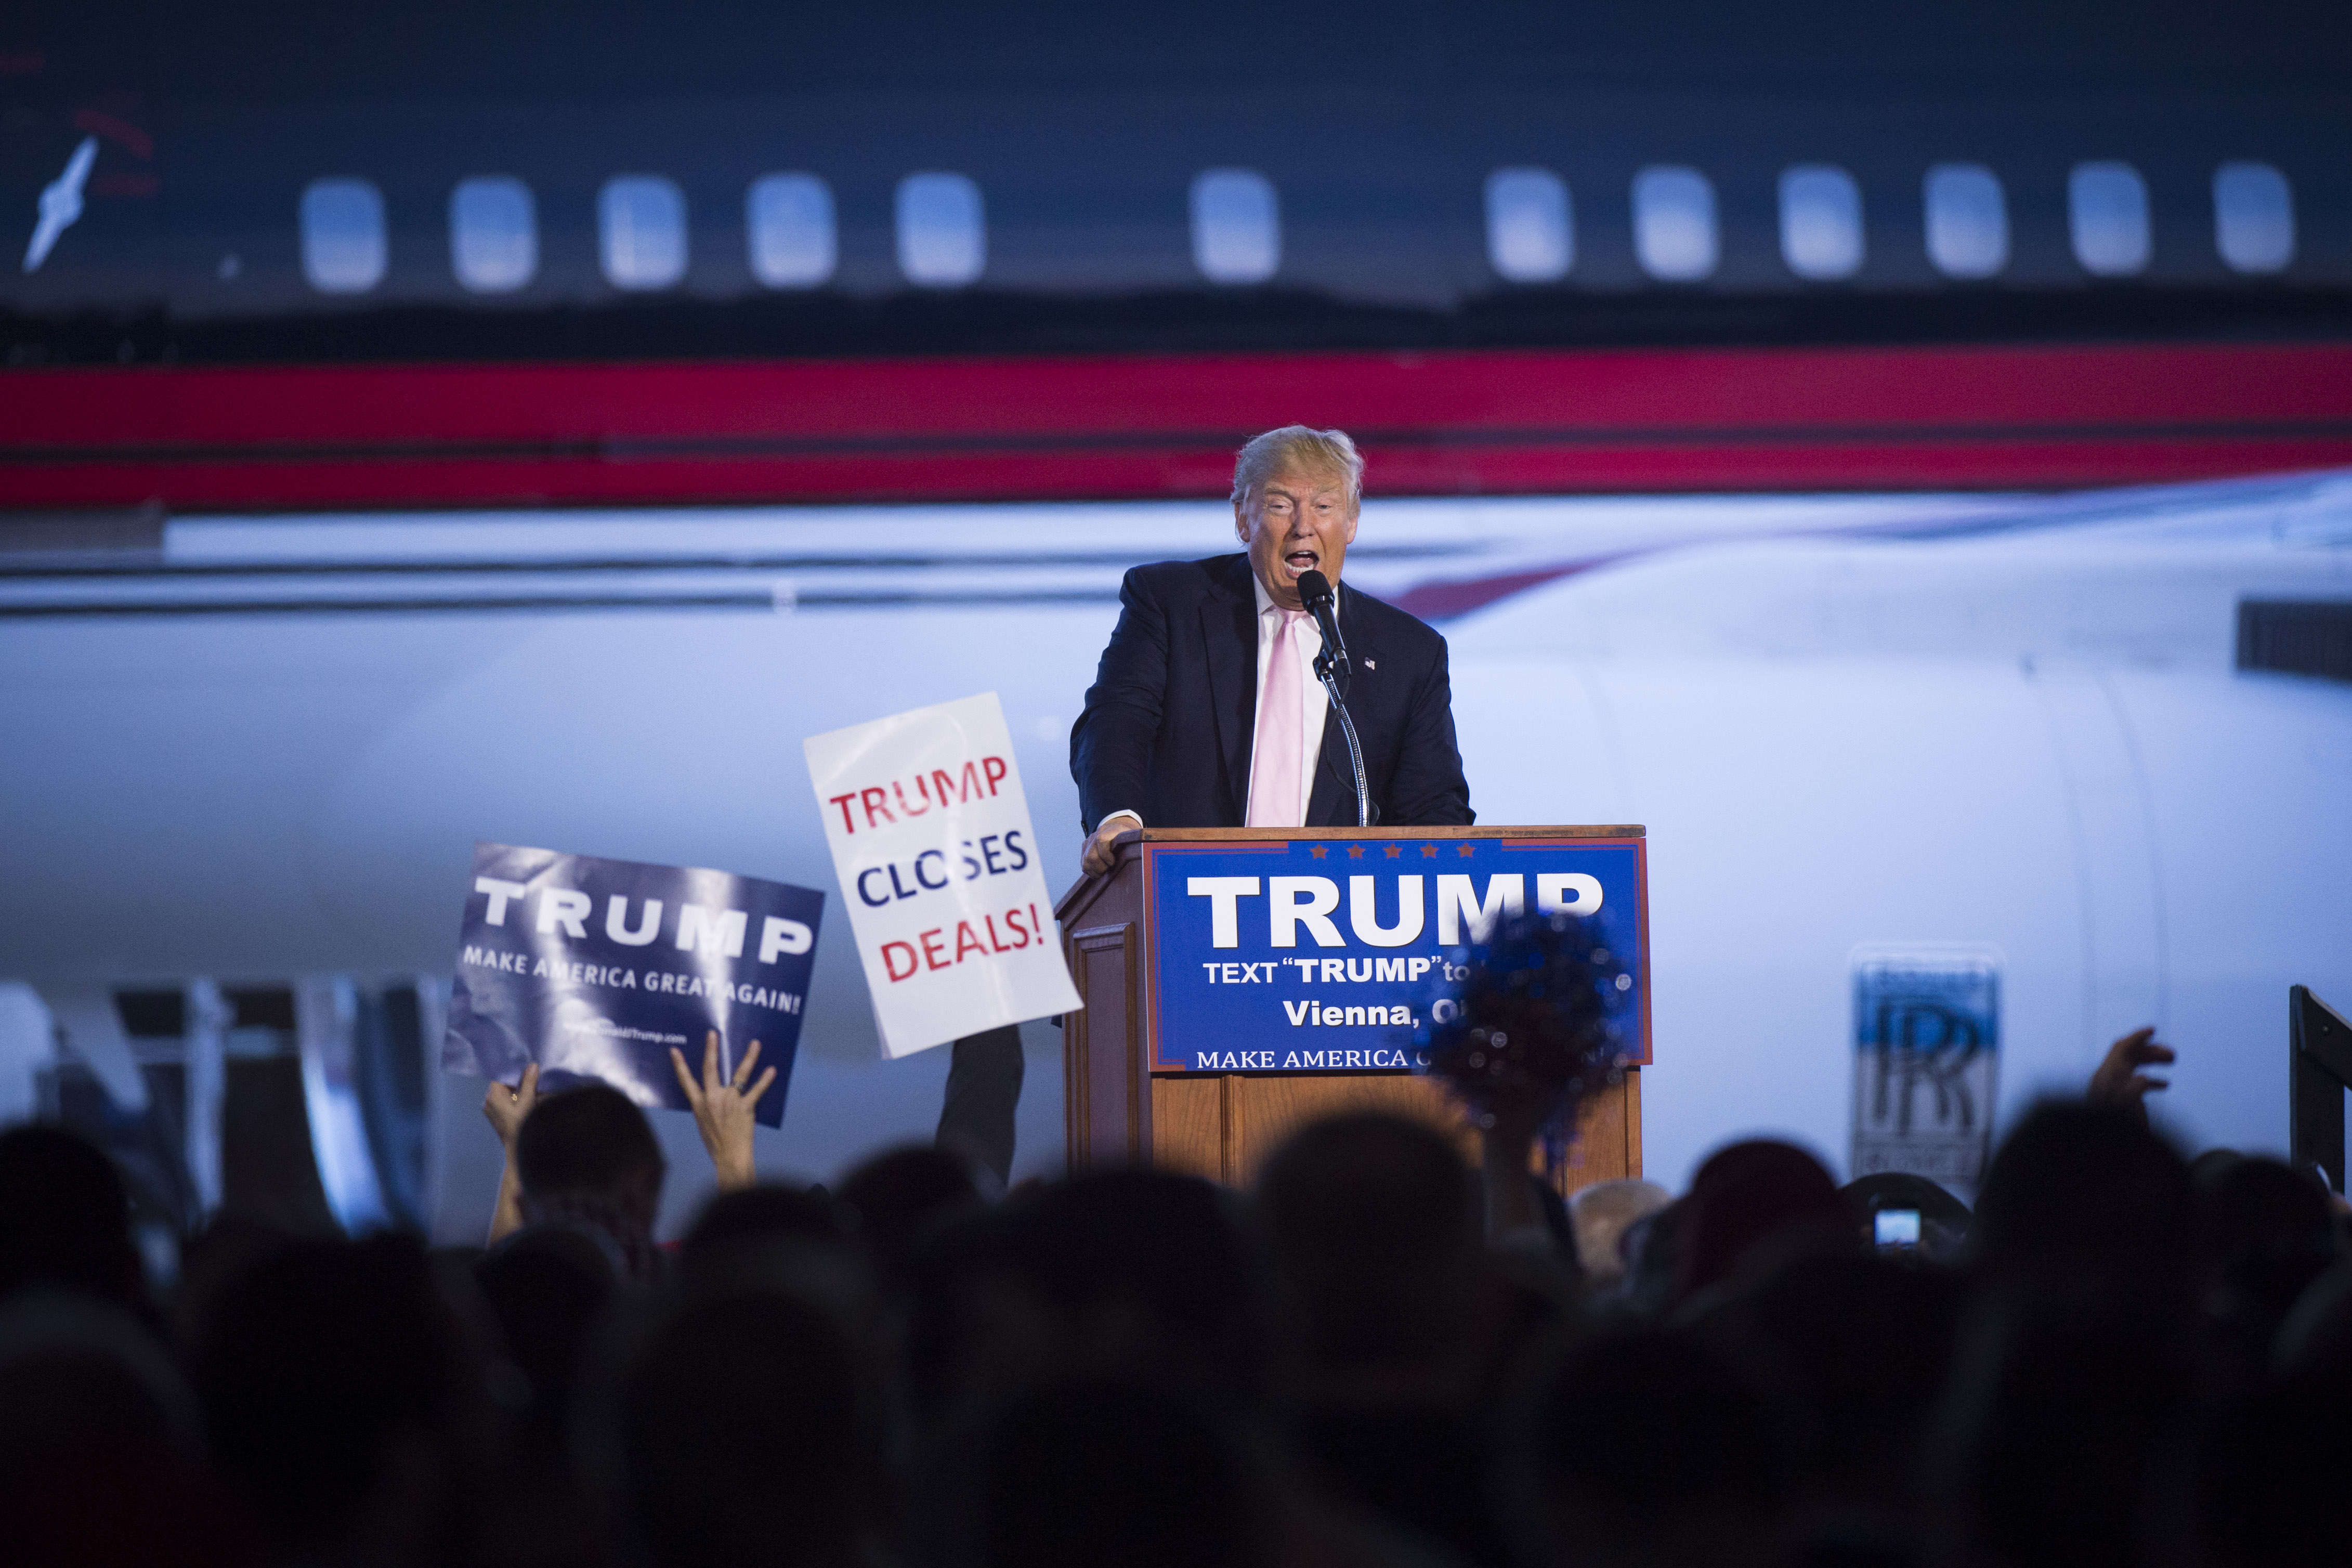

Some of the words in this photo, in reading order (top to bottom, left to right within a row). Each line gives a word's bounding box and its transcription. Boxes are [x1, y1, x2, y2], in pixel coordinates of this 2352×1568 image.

[830, 756, 1007, 834] TRUMP
[857, 831, 1028, 908] CLOSES
[475, 877, 813, 964] TRUMP
[880, 903, 1043, 983] DEALS!
[1187, 873, 1603, 948] TRUMP
[464, 945, 528, 975] MAKE
[532, 958, 636, 990] AMERICA
[644, 972, 715, 998] GREAT
[721, 979, 802, 1015] AGAIN!
[1203, 962, 1278, 984] TEXT
[1443, 961, 1471, 982] to
[1283, 1000, 1420, 1029] Vienna,
[1197, 1051, 1276, 1069] MAKE
[1283, 1049, 1409, 1068] AMERICA
